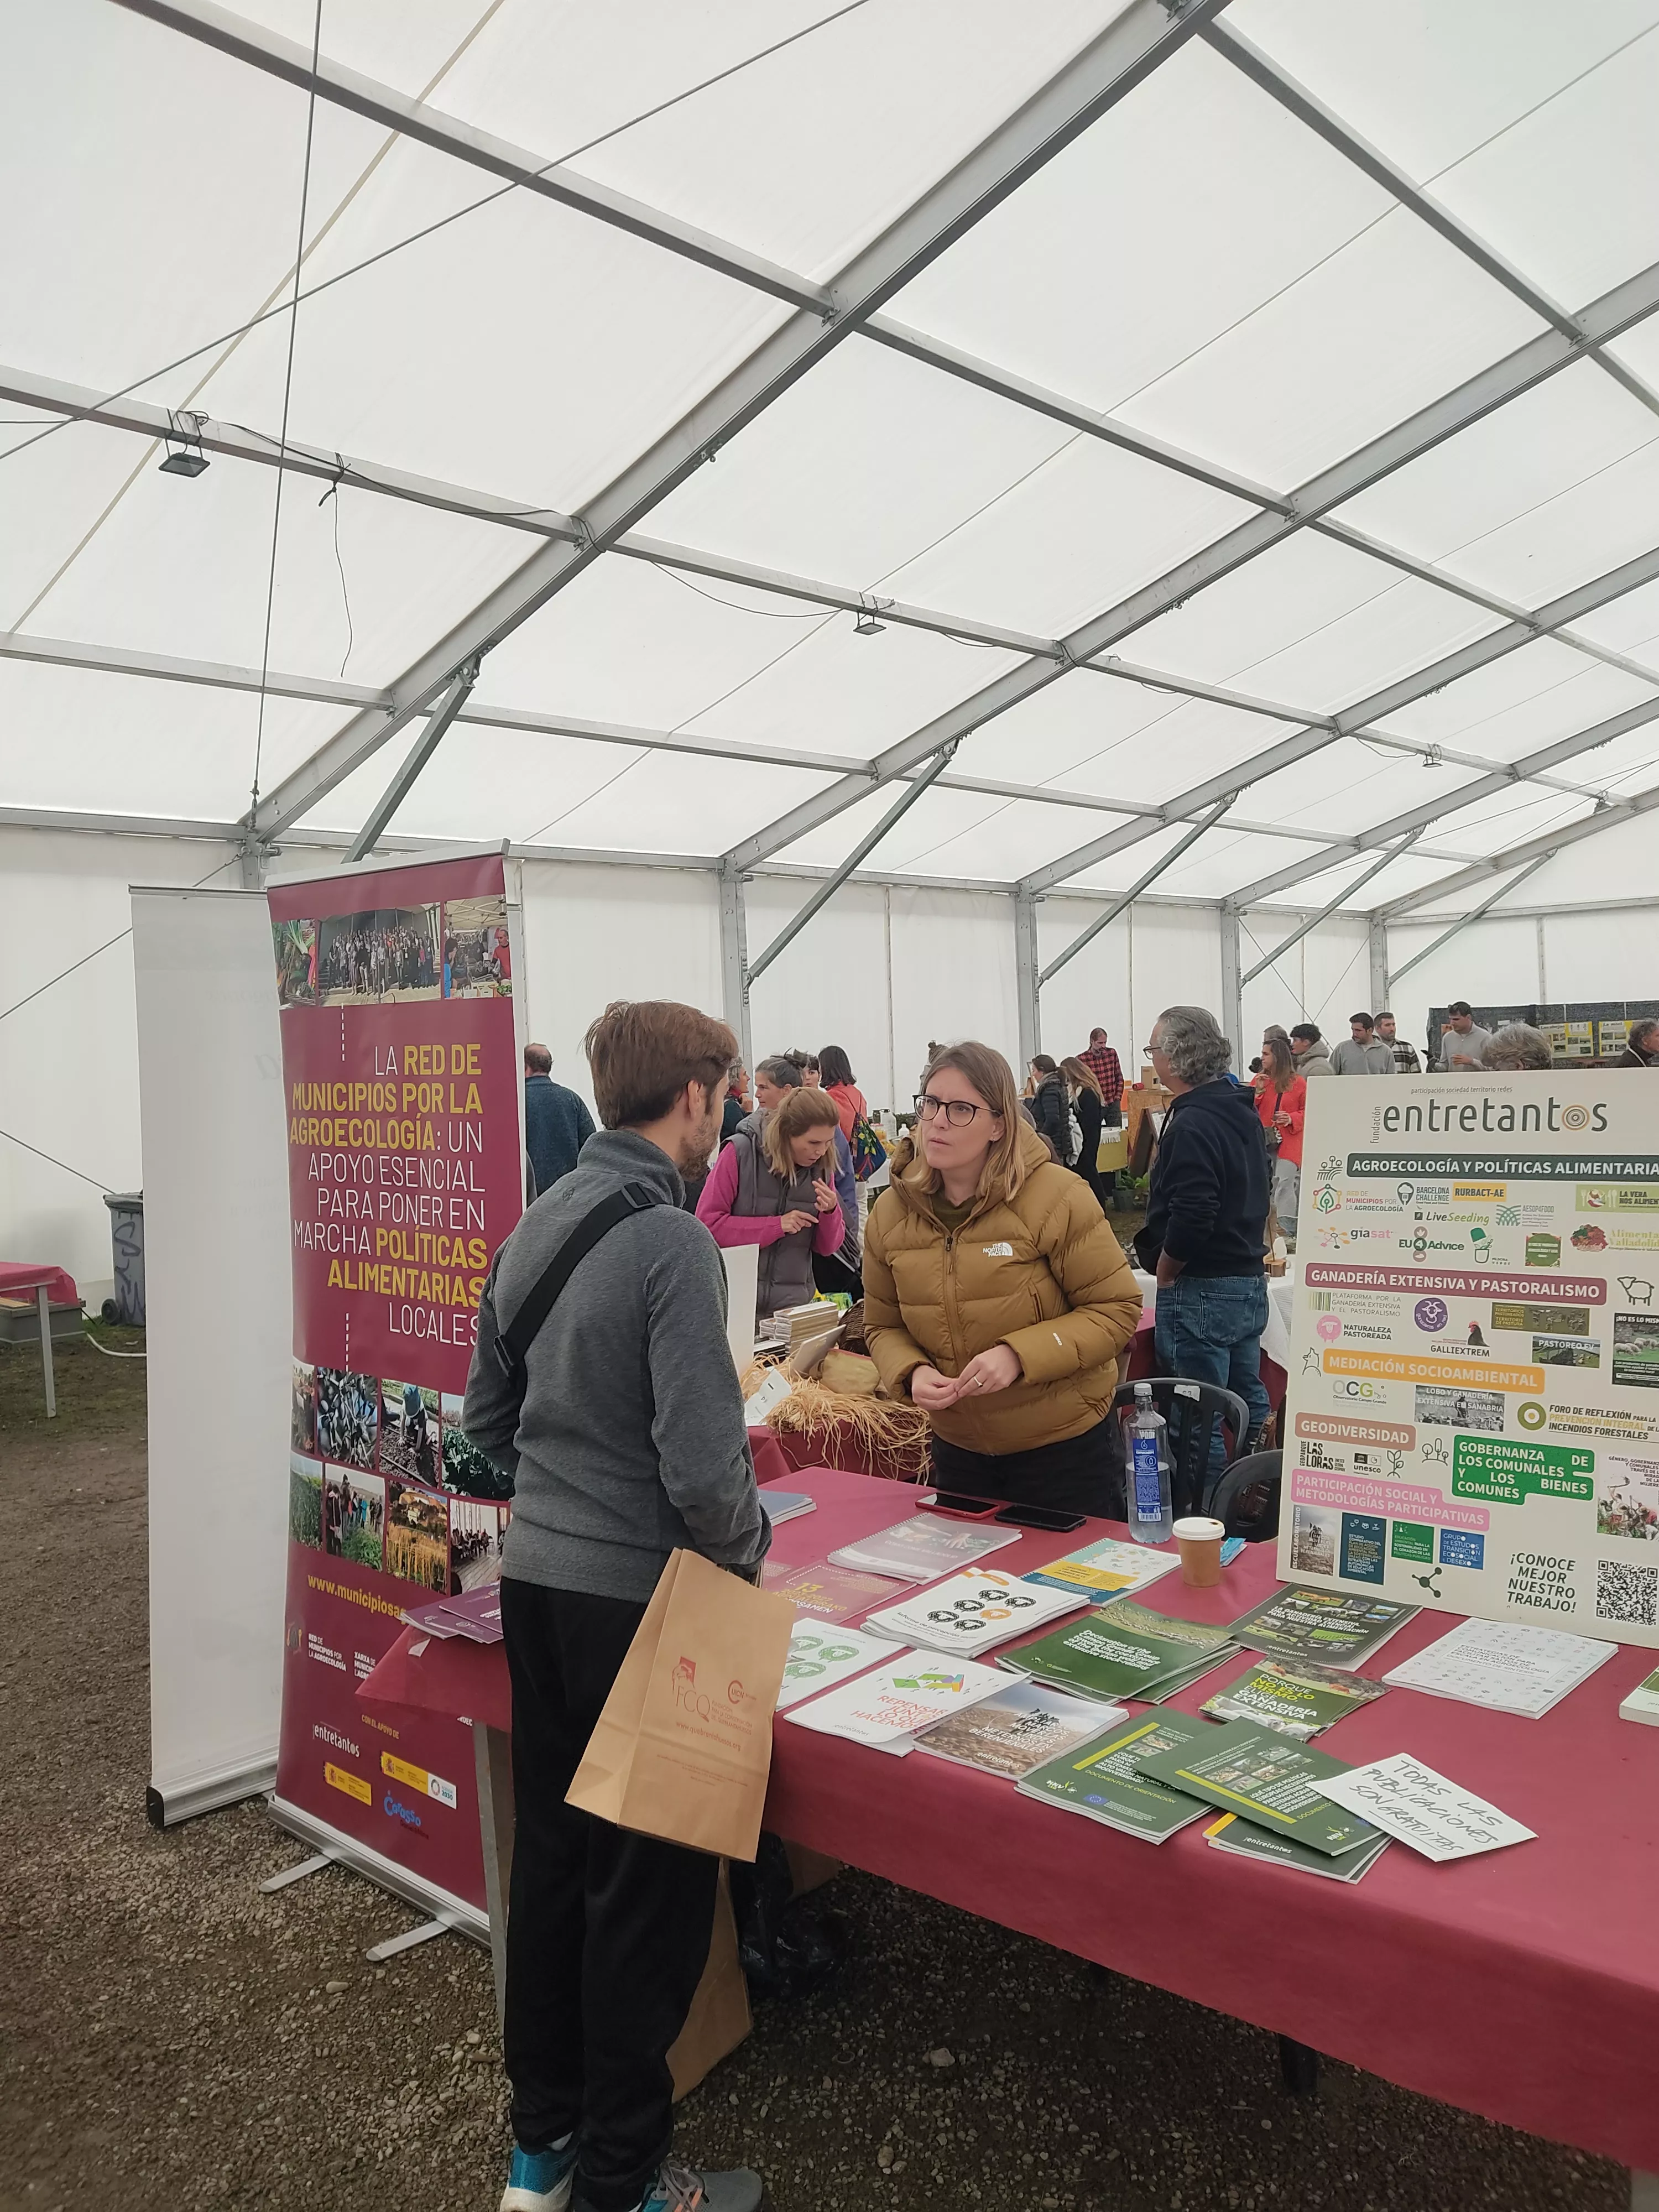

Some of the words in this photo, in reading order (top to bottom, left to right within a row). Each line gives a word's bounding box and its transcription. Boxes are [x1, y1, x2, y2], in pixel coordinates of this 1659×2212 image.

[375, 1046, 398, 1076] LA
[404, 1045, 445, 1075] RED
[451, 1044, 481, 1075] DE
[293, 1082, 397, 1112] MUNICIPIOS
[403, 1083, 443, 1113] POR
[450, 1083, 483, 1114] LA
[1383, 1097, 1608, 1132] entretantos
[290, 1113, 441, 1151] AGROECOLOGÍA:
[448, 1121, 482, 1153] UN
[1370, 1106, 1381, 1144] fundación
[309, 1152, 373, 1183] APOYO
[380, 1155, 484, 1192] ESENCIAL
[1352, 1159, 1459, 1172] AGROECOLOGÍA
[1463, 1161, 1470, 1172] Y
[1475, 1159, 1552, 1173] POLÍTICAS
[1455, 1188, 1504, 1197] RURBACT-AE
[318, 1188, 373, 1220] PARA
[380, 1192, 442, 1228] PONER
[451, 1199, 484, 1230] EN
[1426, 1212, 1489, 1225] LiveSeeding
[294, 1219, 371, 1256] MARCHA
[376, 1224, 487, 1269] POLÍTICAS
[327, 1259, 486, 1308] ALIMENTARIAS
[1312, 1270, 1386, 1285] GANADERÍA
[1390, 1275, 1465, 1290] EXTENSIVA
[1468, 1279, 1478, 1290] Y
[1481, 1280, 1599, 1298] PASTORALISMO
[1350, 1308, 1400, 1317] PASTORALISMO
[1344, 1324, 1391, 1333] NATURALEZA
[1344, 1331, 1391, 1340] PASTOREADA
[1431, 1345, 1490, 1357] GALLIEXTREM
[1538, 1340, 1582, 1350] PASTOREO
[1329, 1357, 1405, 1374] MEDIACIÓN
[1408, 1364, 1537, 1387] SOCIOAMBIENTAL
[1333, 1380, 1373, 1397] OCG
[1453, 1390, 1493, 1400] GANADERÍA
[1417, 1397, 1455, 1407] EXTENSIVA
[1467, 1402, 1504, 1412] SANABRIA
[1549, 1405, 1571, 1413] FORO
[1585, 1408, 1631, 1420] REFLEXIÓN
[1548, 1422, 1593, 1433] INCENDIOS
[1594, 1427, 1648, 1440] FORESTALES
[1549, 1414, 1601, 1425] PREVENCIÓN
[1603, 1419, 1645, 1430] INTEGRAL
[1301, 1421, 1409, 1444] GEODIVERSIDAD
[1307, 1442, 1323, 1455] LAS
[1459, 1441, 1545, 1461] GOBERNANZA
[1572, 1454, 1588, 1467] DE
[1306, 1455, 1333, 1470] LORAS
[1354, 1464, 1381, 1473] unesco
[1458, 1454, 1483, 1467] LOS
[1485, 1459, 1564, 1477] COMUNALES
[1297, 1475, 1383, 1497] PARTICIPACIÓN
[1385, 1489, 1427, 1504] SOCIAL
[1429, 1494, 1437, 1504] Y
[1457, 1480, 1520, 1499] COMUNES
[1458, 1467, 1465, 1478] Y
[1490, 1473, 1515, 1484] LOS
[1541, 1479, 1588, 1494] BIENES
[1296, 1488, 1385, 1510] METODOLOGÍAS
[1387, 1503, 1484, 1525] PARTICIPATIVAS
[1292, 1507, 1301, 1569] ESCUELABORATORIO
[1510, 1552, 1575, 1571] ¡CONOCE
[1517, 1566, 1567, 1584] MEJOR
[1509, 1578, 1575, 1599] NUESTRO
[1507, 1591, 1577, 1613] TRABAJO!
[309, 1633, 317, 1642] RED
[309, 1642, 333, 1656] MUNICIPIOS
[314, 1652, 346, 1672] AGROECOLOGÍA
[732, 1688, 744, 1698] UICN
[1244, 1686, 1277, 1700] ELIGE
[1250, 1682, 1298, 1702] MISMO,
[1255, 1678, 1276, 1688] NO
[1260, 1673, 1312, 1694] PORQUE
[676, 1686, 710, 1722] FCQ
[877, 1695, 948, 1714] REPENSAR
[1233, 1693, 1305, 1719] EXTENSIVA
[1239, 1690, 1317, 1717] GANADERÍA
[315, 1724, 359, 1757] entretantos
[393, 1730, 399, 1740] DE
[969, 1728, 1045, 1753] BERENJENALES
[982, 1726, 1038, 1745] METERNOS
[442, 1790, 453, 1800] 2030
[1084, 1770, 1124, 1787] DOCUMENTO
[1134, 1787, 1177, 1803] ORIENTACIÓN
[1394, 1760, 1452, 1796] TODAS
[1458, 1802, 1503, 1827] LAS
[1350, 1785, 1395, 1804] SON
[1380, 1804, 1464, 1851] GRATUITAS
